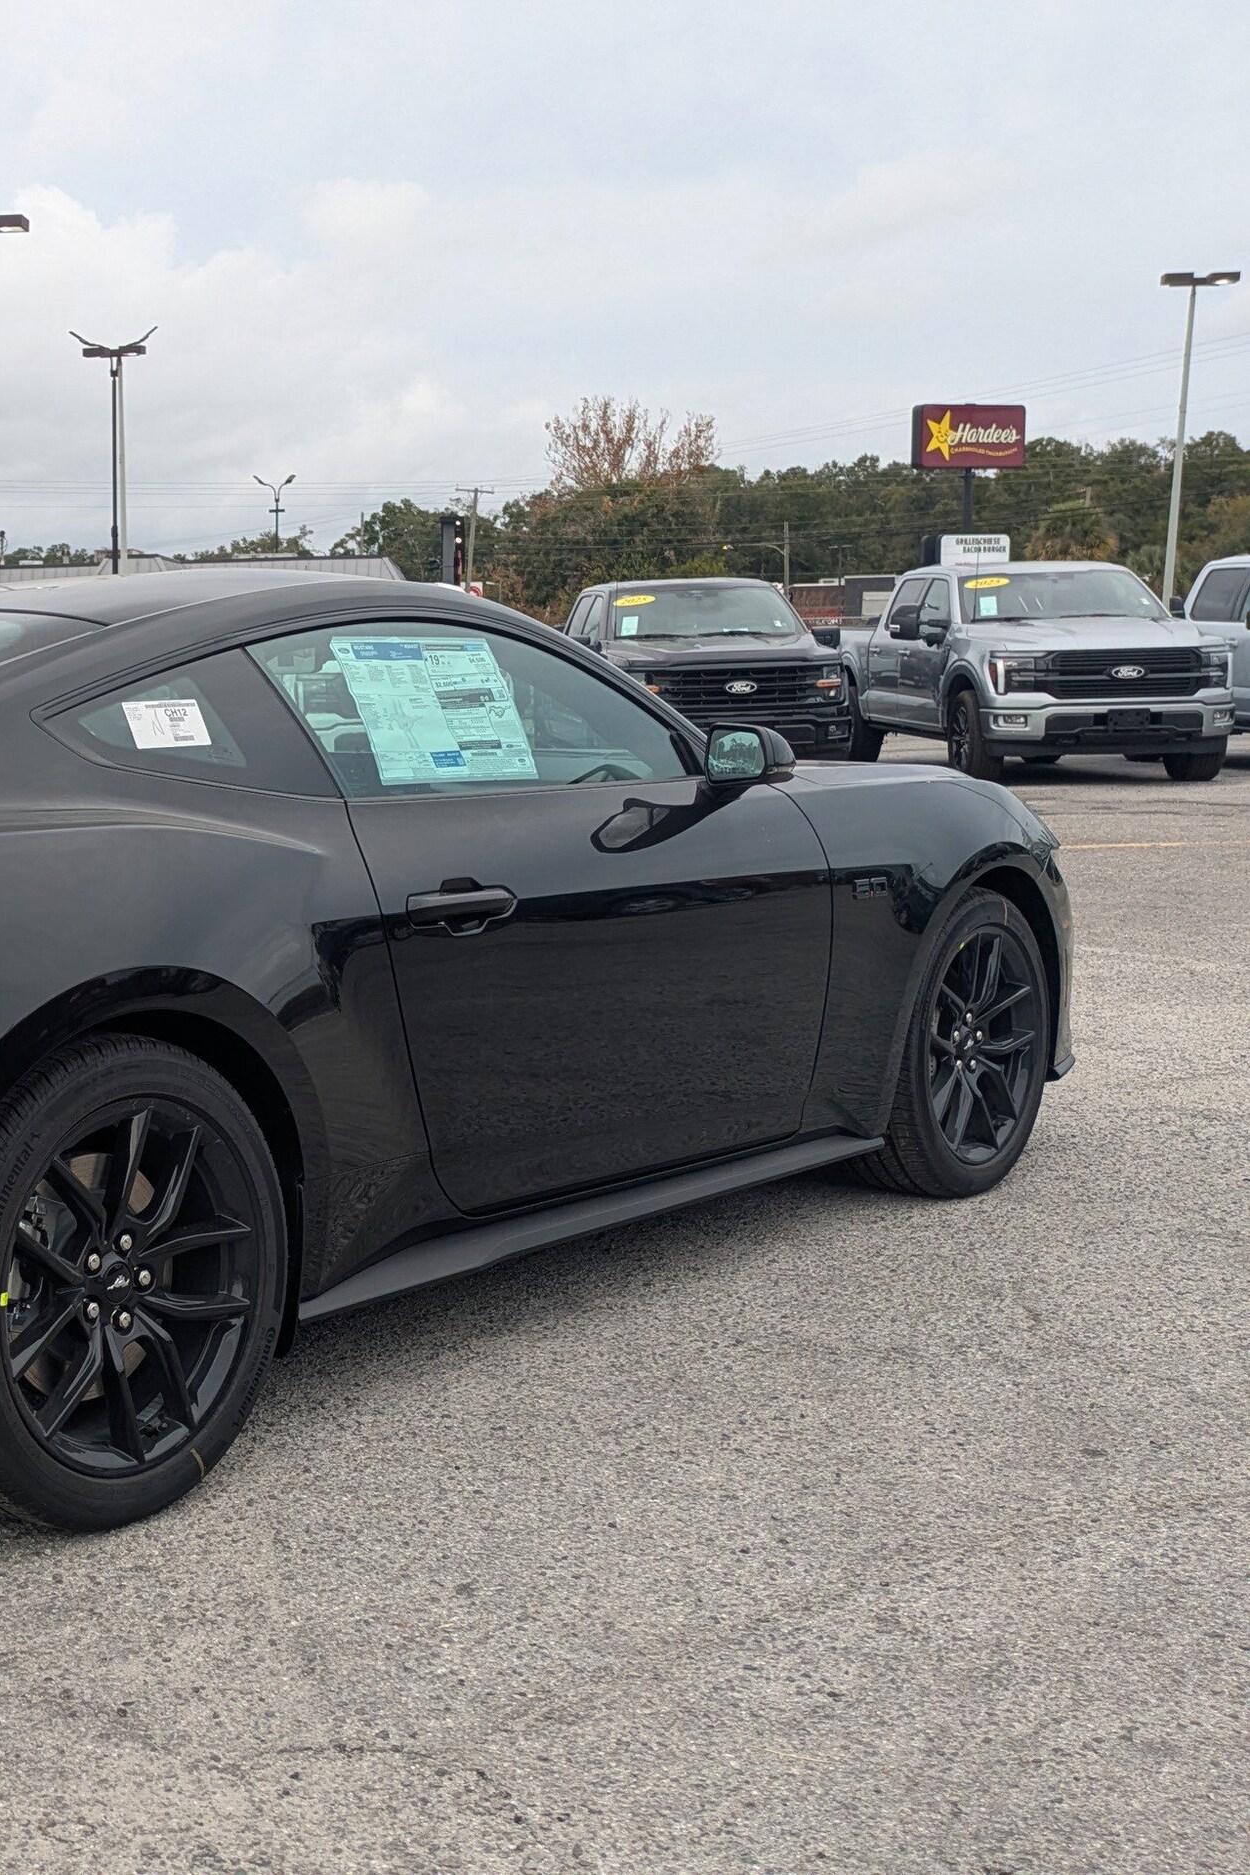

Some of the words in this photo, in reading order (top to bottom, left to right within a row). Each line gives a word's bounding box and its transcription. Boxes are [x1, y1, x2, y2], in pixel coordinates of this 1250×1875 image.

[947, 422, 1021, 446] Hardee's
[1116, 666, 1140, 678] Ford
[730, 681, 753, 692] Ford
[164, 708, 188, 717] CH12
